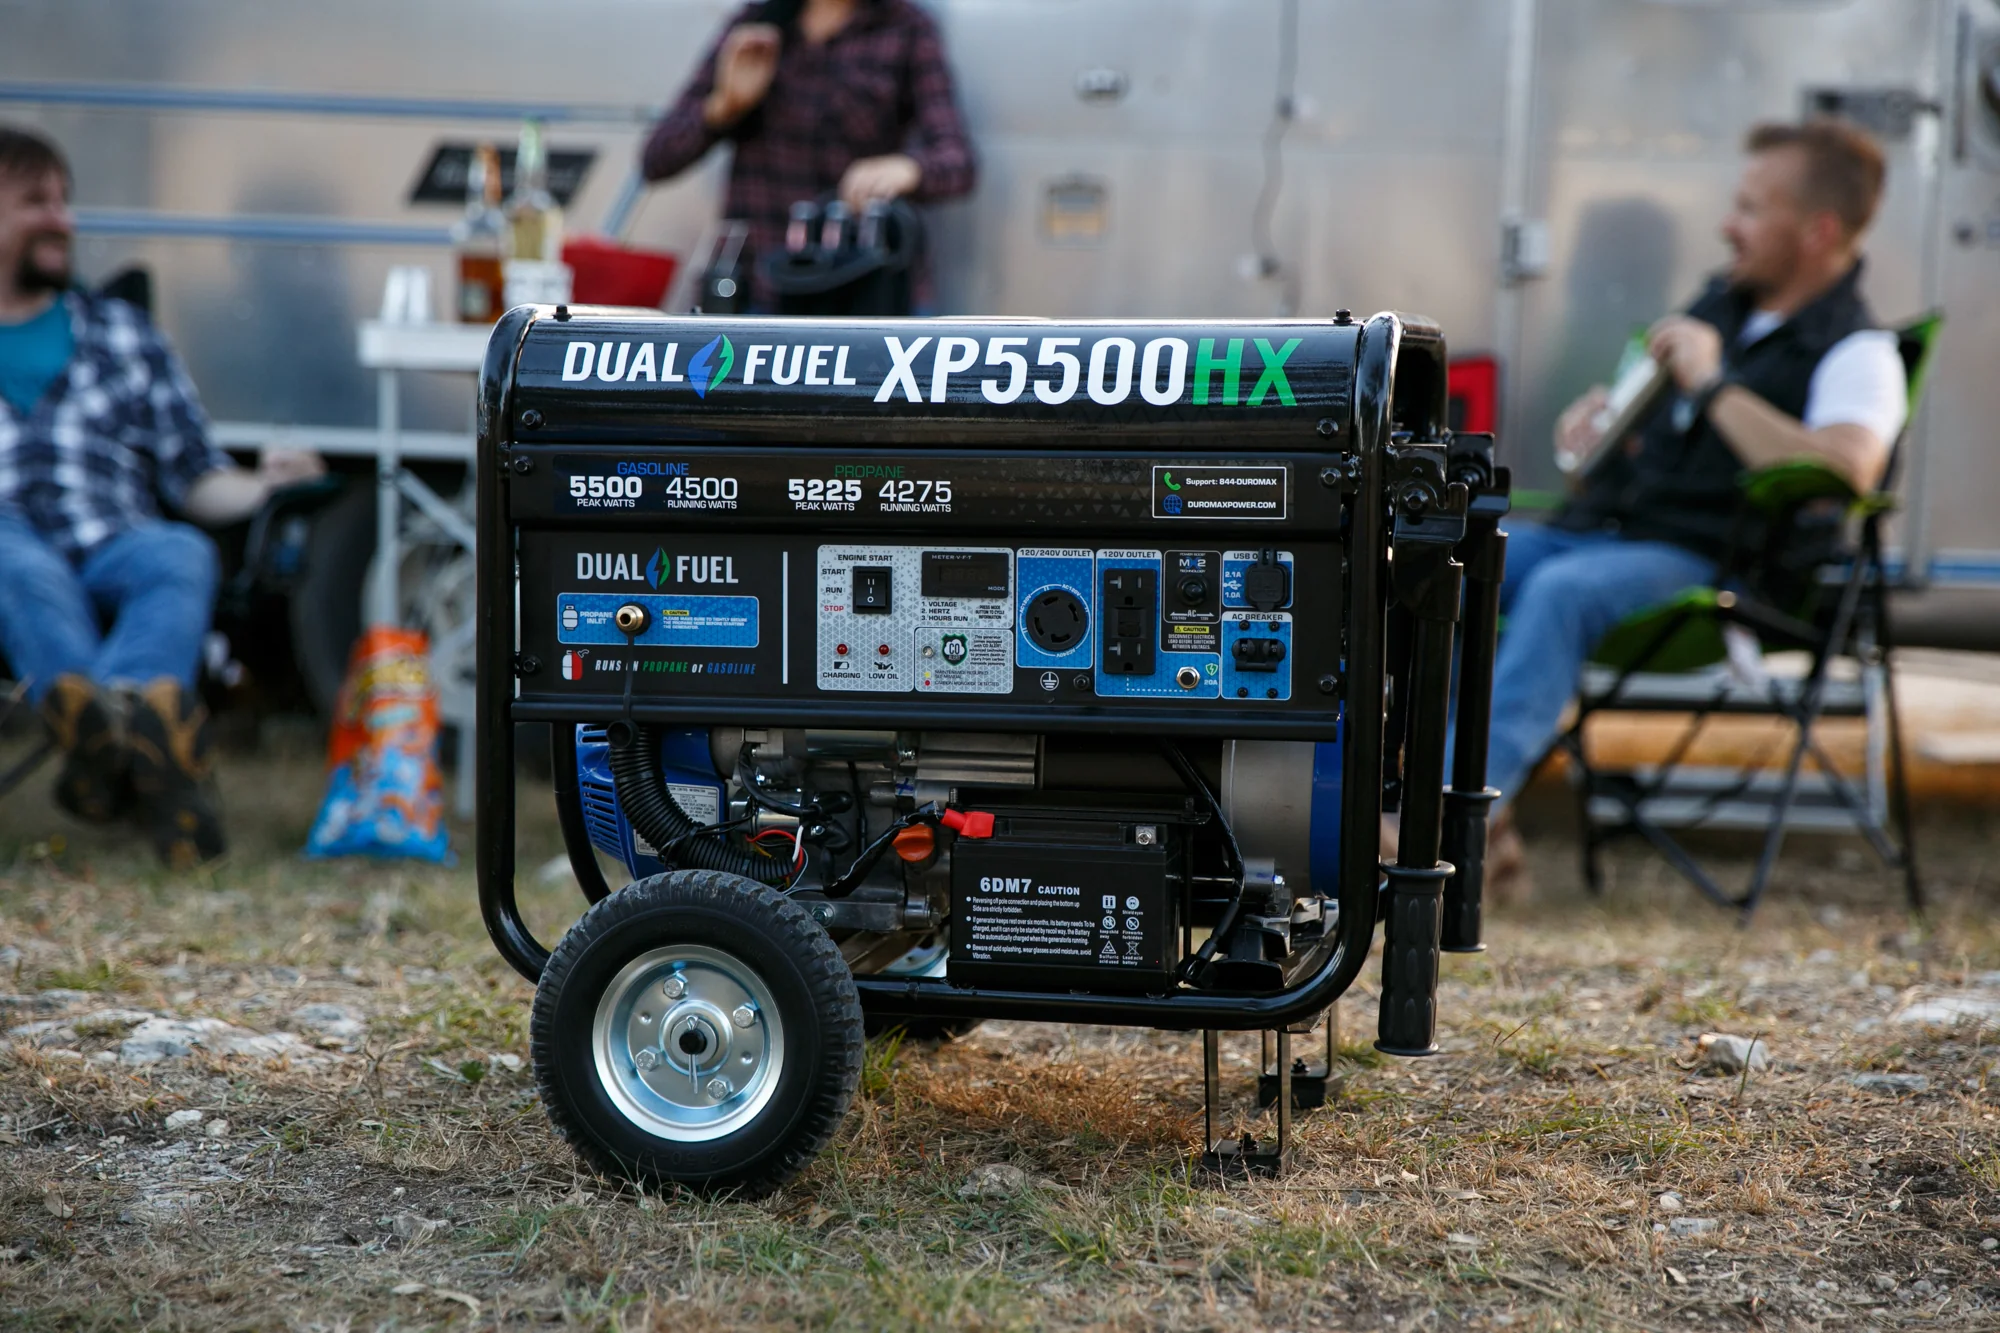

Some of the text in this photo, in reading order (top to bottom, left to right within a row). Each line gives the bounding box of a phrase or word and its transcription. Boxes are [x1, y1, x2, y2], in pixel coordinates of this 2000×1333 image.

[562, 337, 1303, 406] DUAL FUEL XP5500HX
[618, 462, 689, 475] GASOLINE
[835, 466, 904, 478] PROPANE
[570, 476, 738, 500] 5500 4500
[1186, 478, 1218, 486] Support:
[788, 479, 951, 502] 5225 4275
[577, 498, 737, 509] PEAK WATTS RUNNING WATTS
[796, 502, 951, 512] PEAK WATTS RUNNING WATTS
[577, 553, 738, 584] DUAL FUEL
[949, 643, 960, 655] CO
[595, 660, 756, 674] RUNS N PROPANE or GASOLINE
[980, 877, 1080, 895] 6DM7 CAUTION
